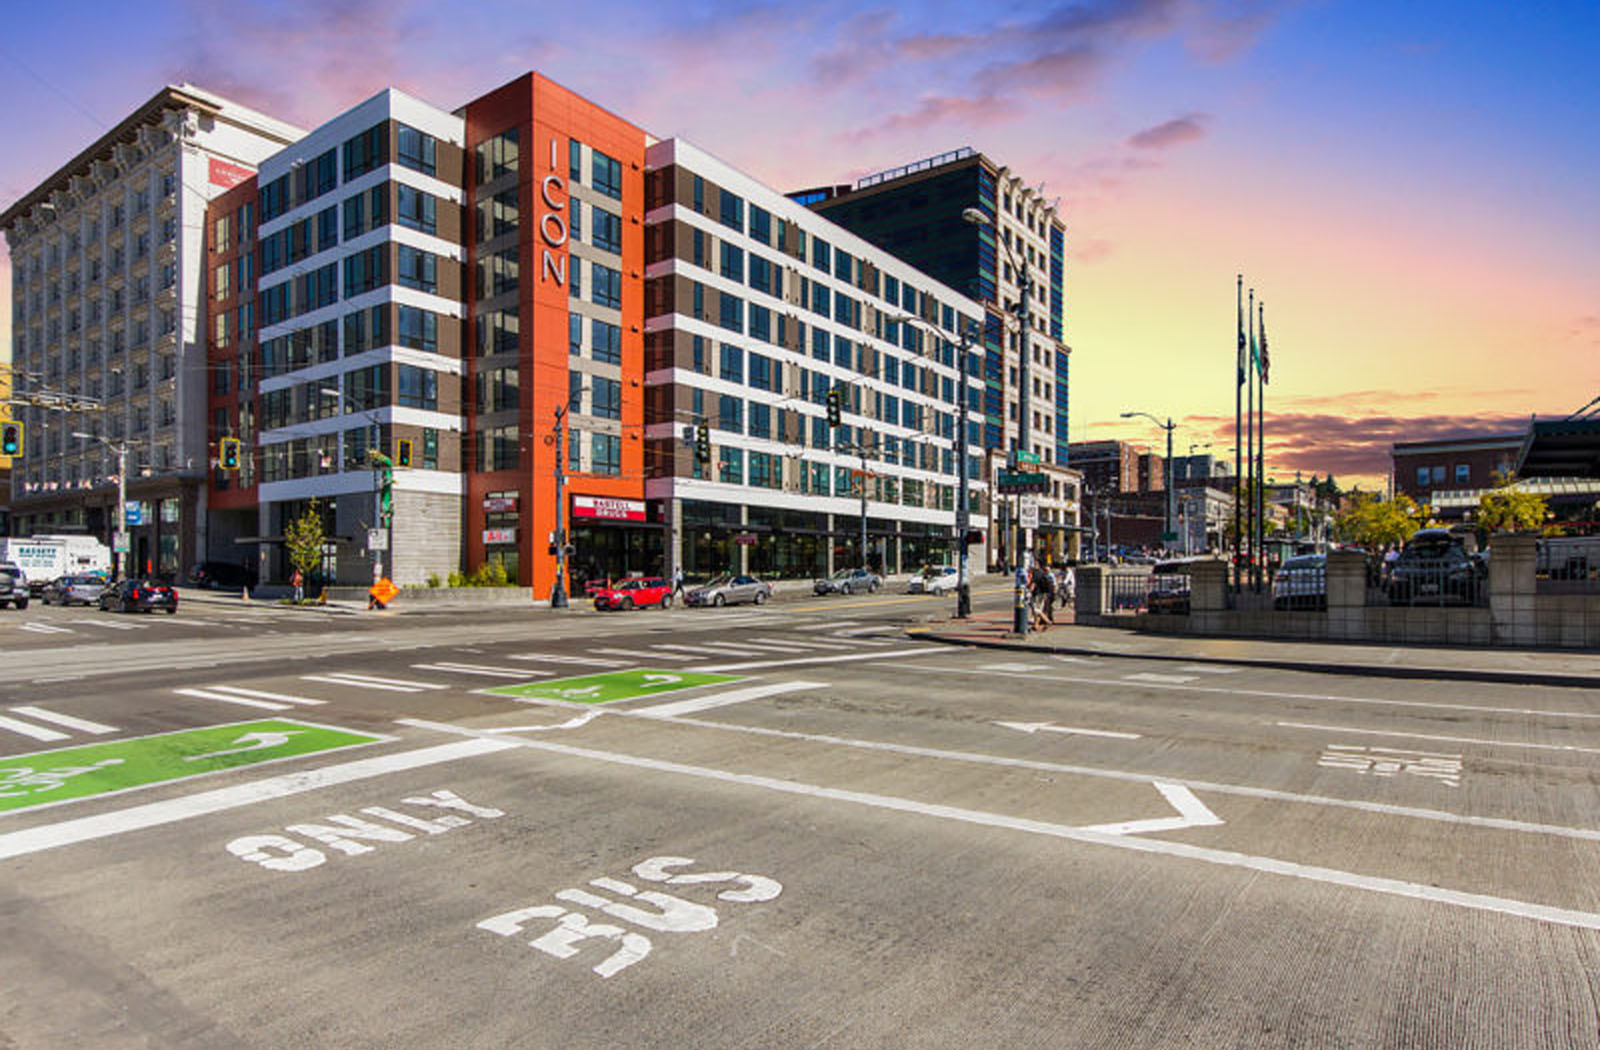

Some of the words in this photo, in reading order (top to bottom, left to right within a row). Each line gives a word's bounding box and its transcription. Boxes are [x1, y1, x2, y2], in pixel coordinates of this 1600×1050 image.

[541, 139, 566, 286] ICON
[225, 790, 505, 872] ONLY
[476, 855, 783, 979] BUS
